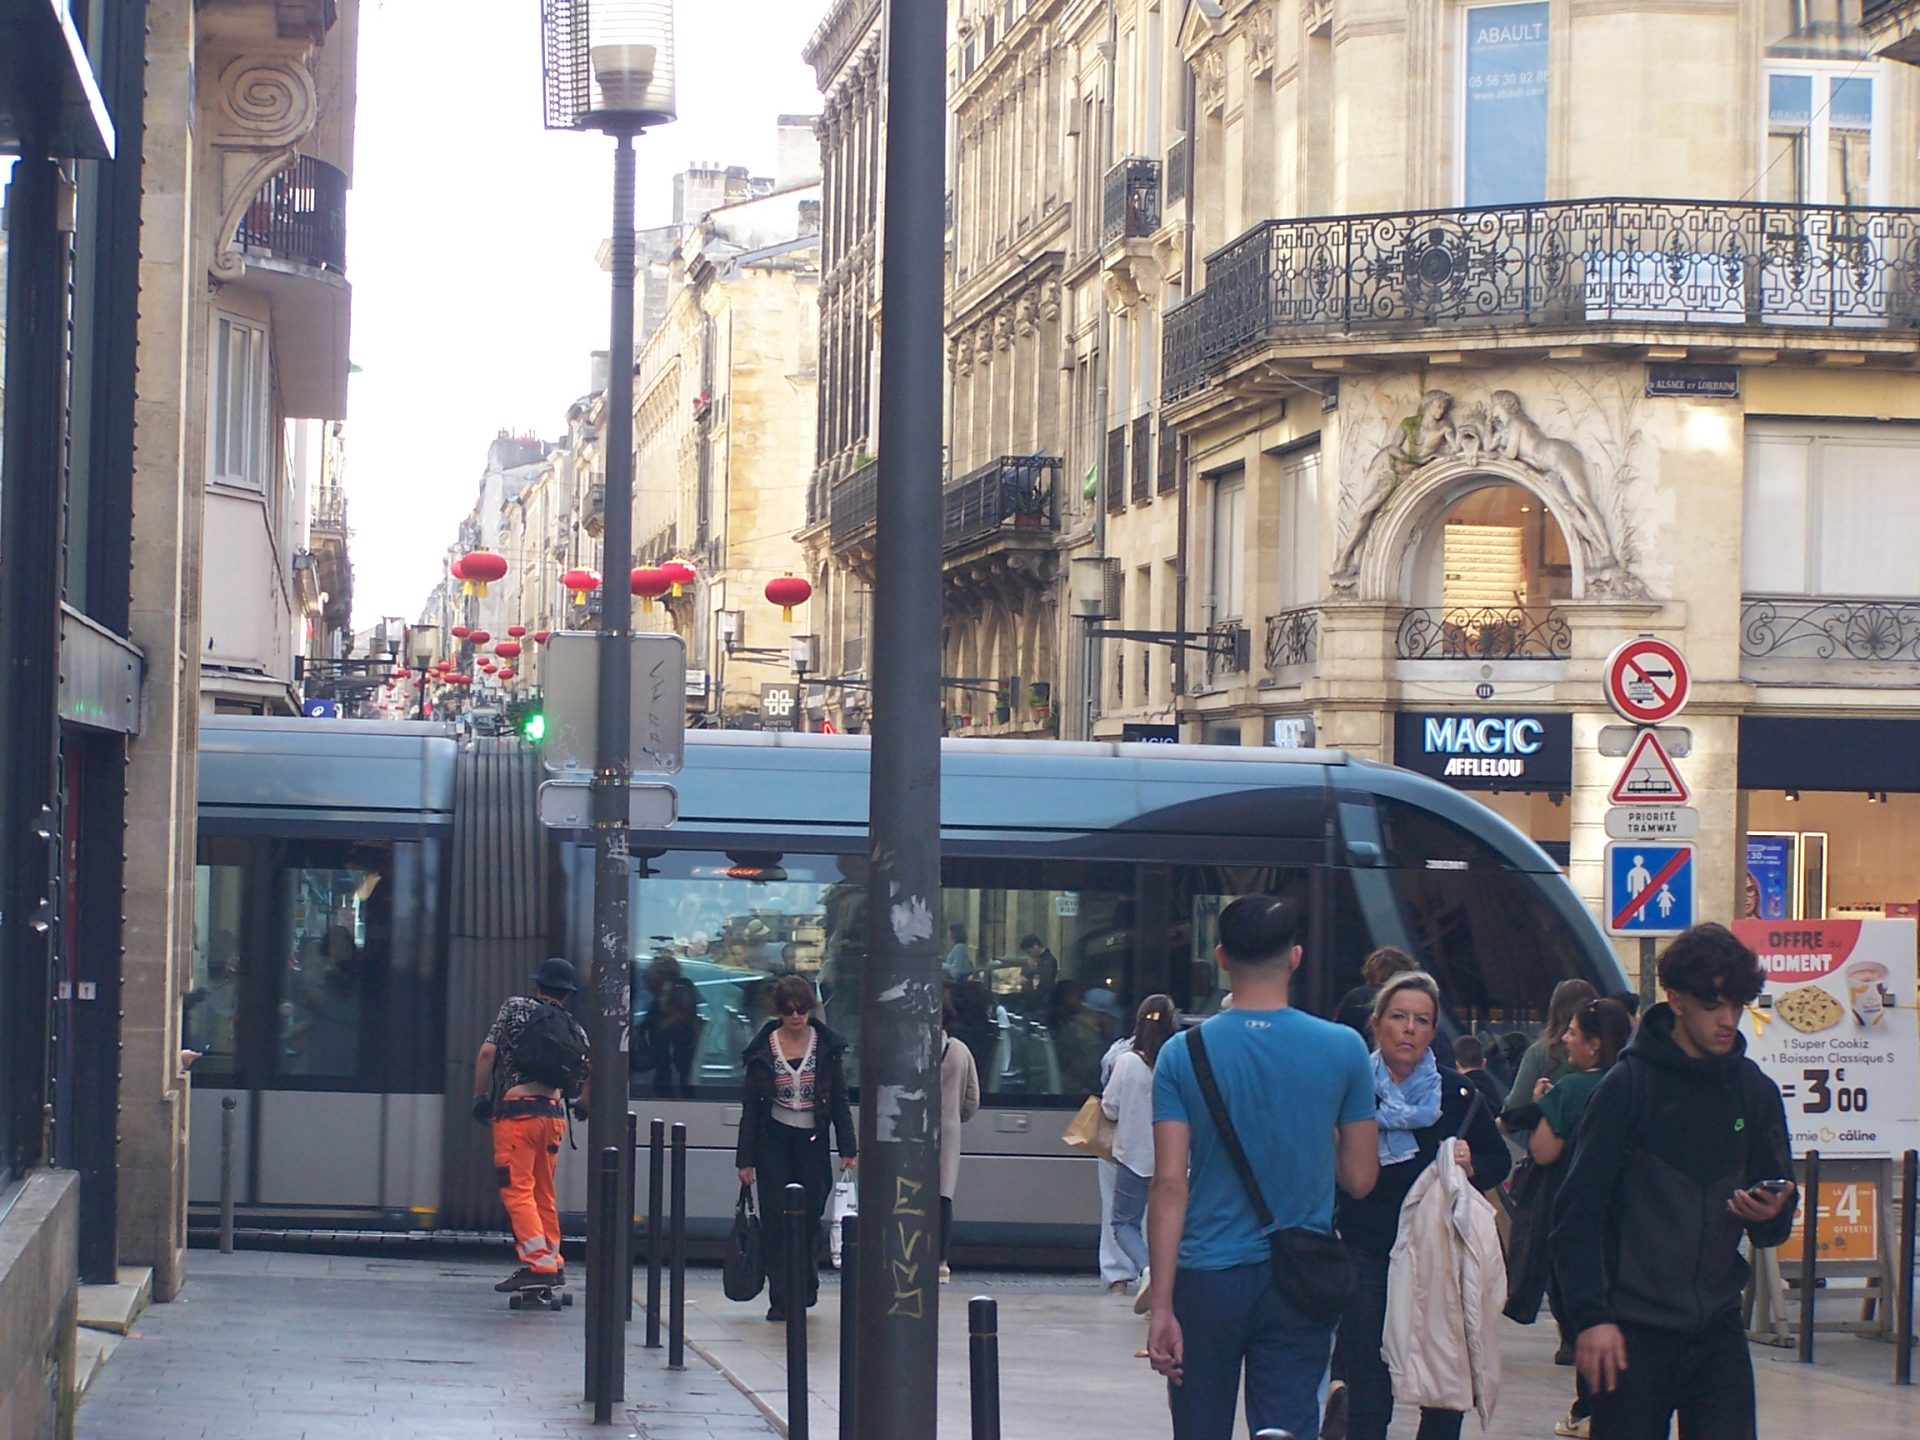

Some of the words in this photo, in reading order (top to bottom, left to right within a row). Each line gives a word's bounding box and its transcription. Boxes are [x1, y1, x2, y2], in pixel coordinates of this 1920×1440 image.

[1476, 22, 1543, 44] ABAULT
[1469, 75, 1482, 88] 05
[1502, 72, 1516, 85] 30
[1519, 71, 1533, 83] 92
[1698, 381, 1736, 390] LORRAINE
[1424, 717, 1544, 754] MAGIC
[1444, 757, 1524, 777] AFFLELOU
[1628, 811, 1677, 821] PRIORITÉ
[1628, 824, 1678, 833] TRAMWAY
[1768, 931, 1825, 950] OFFRE
[1758, 953, 1833, 973] MOMENT
[1790, 1038, 1827, 1051] Super
[1829, 1037, 1870, 1049] Cookiz
[1771, 1053, 1776, 1063] 1
[1779, 1053, 1825, 1063] Boisson
[1827, 1052, 1885, 1066] Classique
[1886, 1053, 1895, 1063] S
[1795, 1129, 1819, 1142] mie
[1838, 1129, 1877, 1142] câline
[1835, 1184, 1862, 1225] 4
